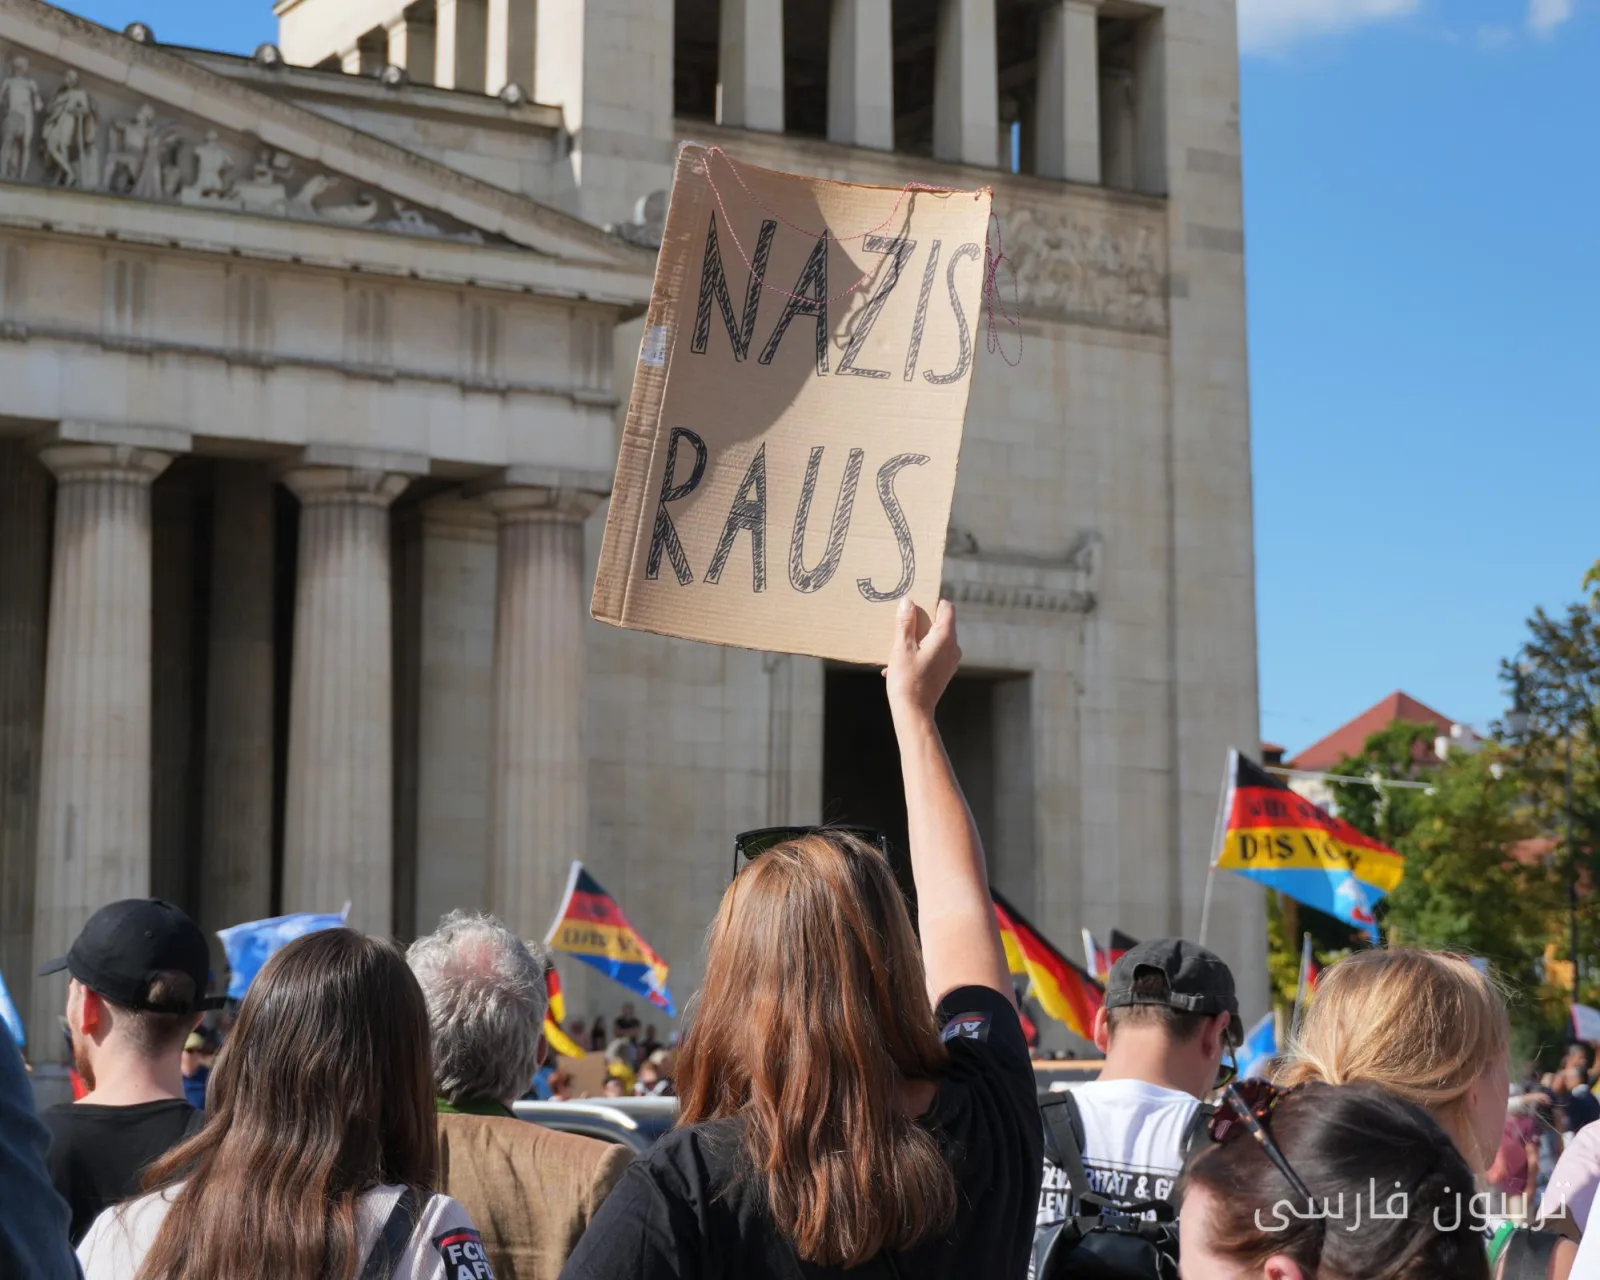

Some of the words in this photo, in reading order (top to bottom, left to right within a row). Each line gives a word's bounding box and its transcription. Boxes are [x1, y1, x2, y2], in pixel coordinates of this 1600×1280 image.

[690, 208, 982, 385] NAZIS
[644, 426, 932, 603] RAUS
[447, 1241, 489, 1265] FCK
